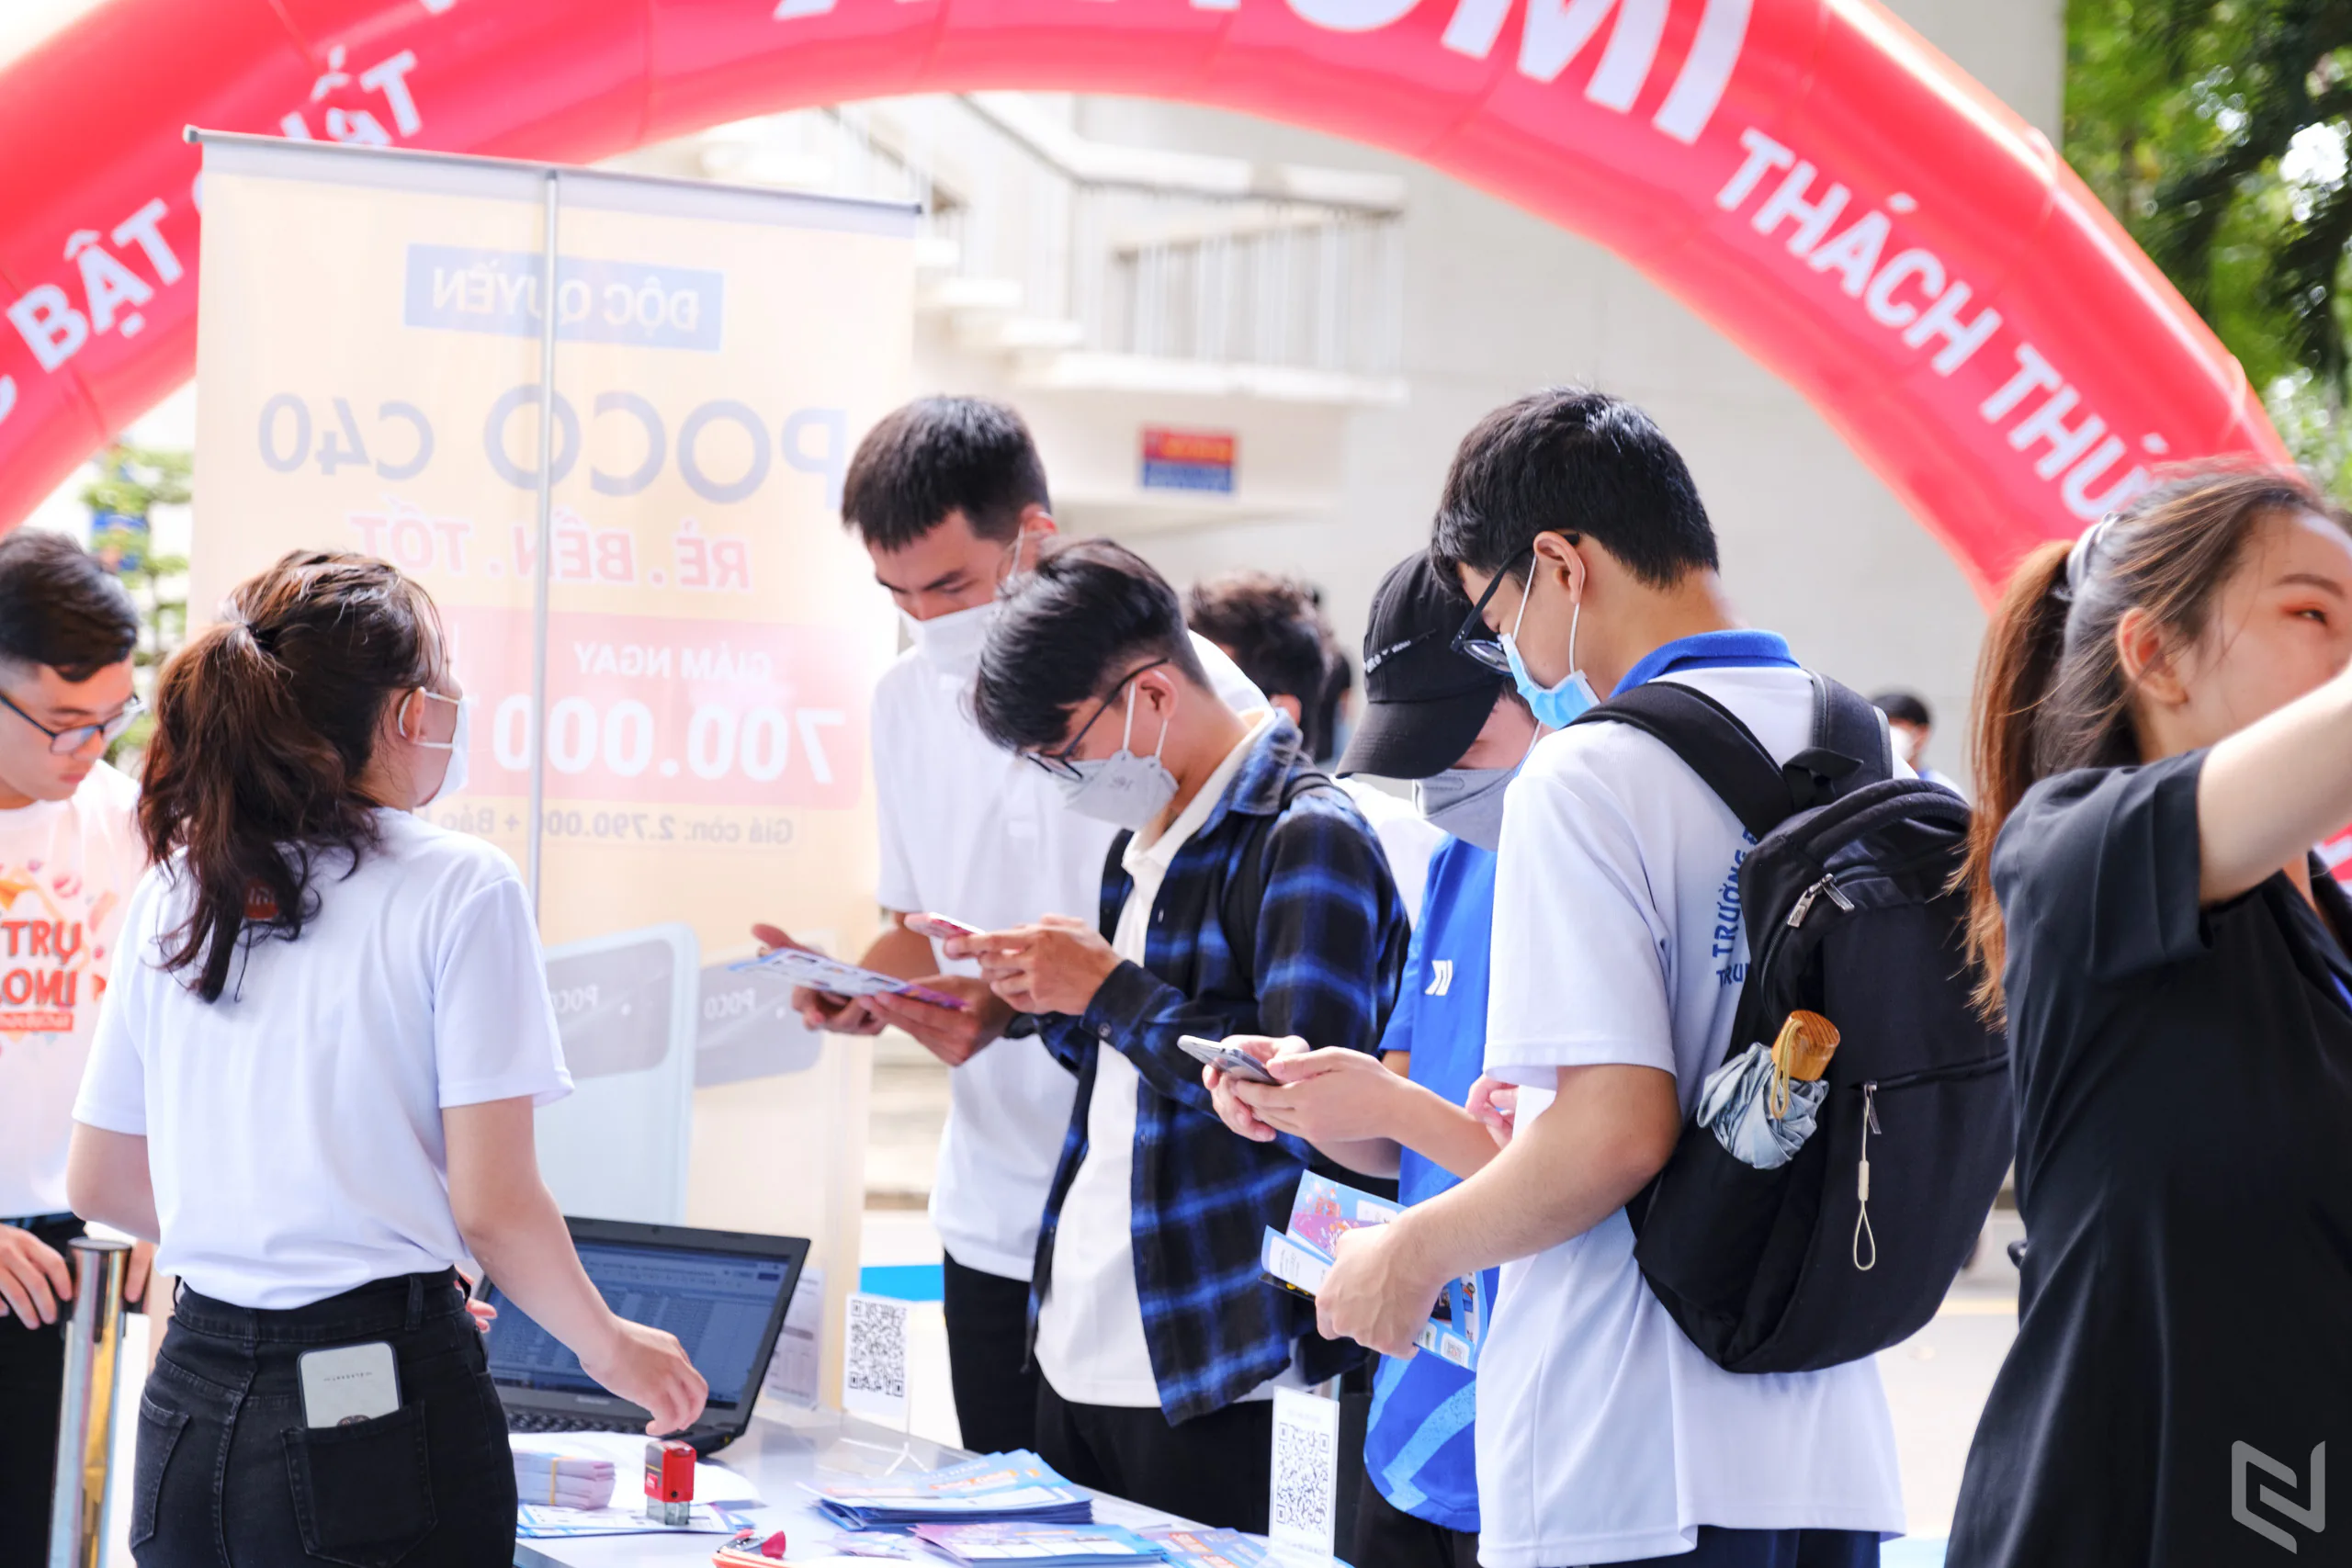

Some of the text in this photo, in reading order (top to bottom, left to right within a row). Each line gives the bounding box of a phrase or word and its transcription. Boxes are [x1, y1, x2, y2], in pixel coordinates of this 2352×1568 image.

[6, 197, 185, 374] BẬT
[1714, 127, 2169, 520] THÁCH THỨ
[0, 969, 77, 1007] OMI
[1716, 963, 1750, 988] TRU
